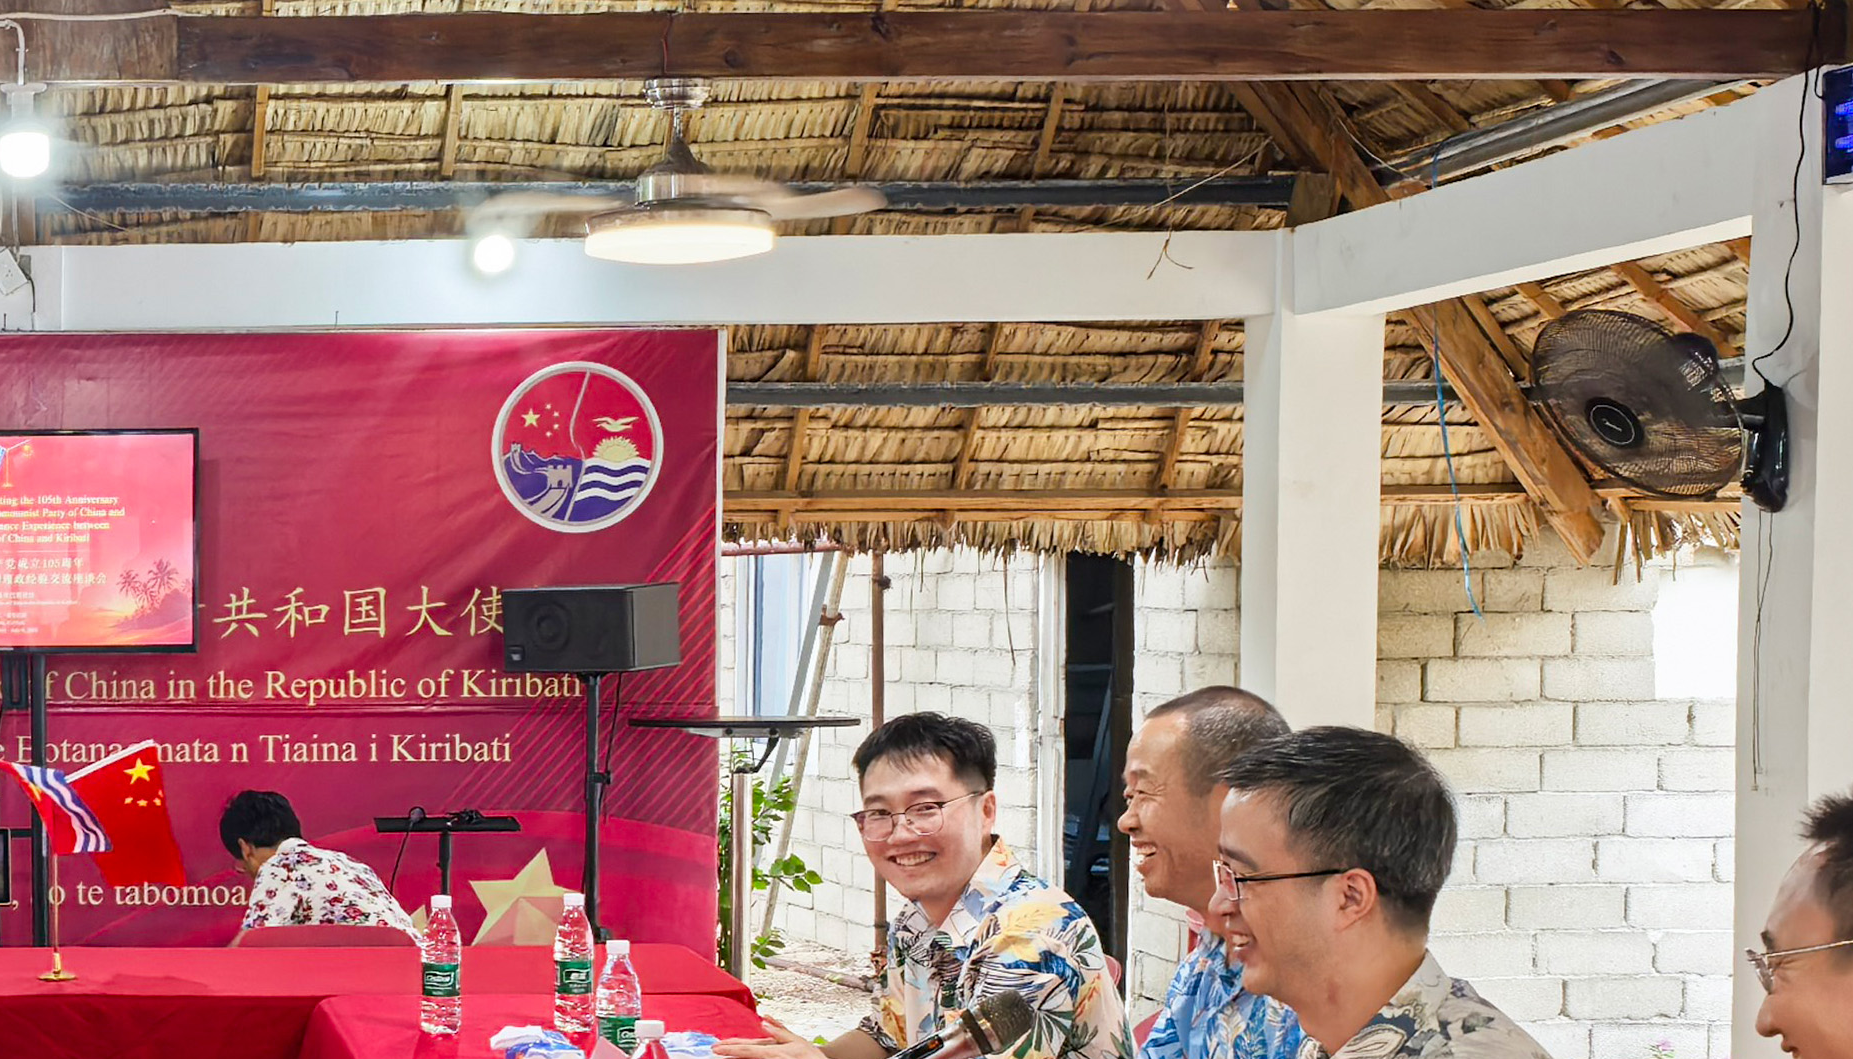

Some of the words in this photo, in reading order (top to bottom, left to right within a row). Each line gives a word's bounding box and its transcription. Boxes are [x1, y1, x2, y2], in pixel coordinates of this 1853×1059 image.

[20, 496, 34, 505] the
[65, 496, 119, 506] Anniversary
[42, 508, 65, 519] Party
[68, 508, 79, 517] of
[80, 507, 106, 517] China
[108, 507, 125, 517] and
[22, 521, 71, 532] Experience
[73, 520, 110, 530] between
[8, 533, 34, 543] China
[37, 534, 53, 543] and
[55, 533, 90, 543] Kiribati
[65, 670, 156, 699] China
[167, 669, 196, 699] in
[207, 670, 253, 699] the
[265, 669, 407, 706] Republic
[418, 669, 455, 698] of
[461, 669, 583, 698] Kiribati
[230, 743, 249, 763] n
[259, 734, 357, 763] Tiaina
[369, 734, 378, 763] i
[390, 733, 511, 763] Kiribati
[76, 881, 104, 905] te
